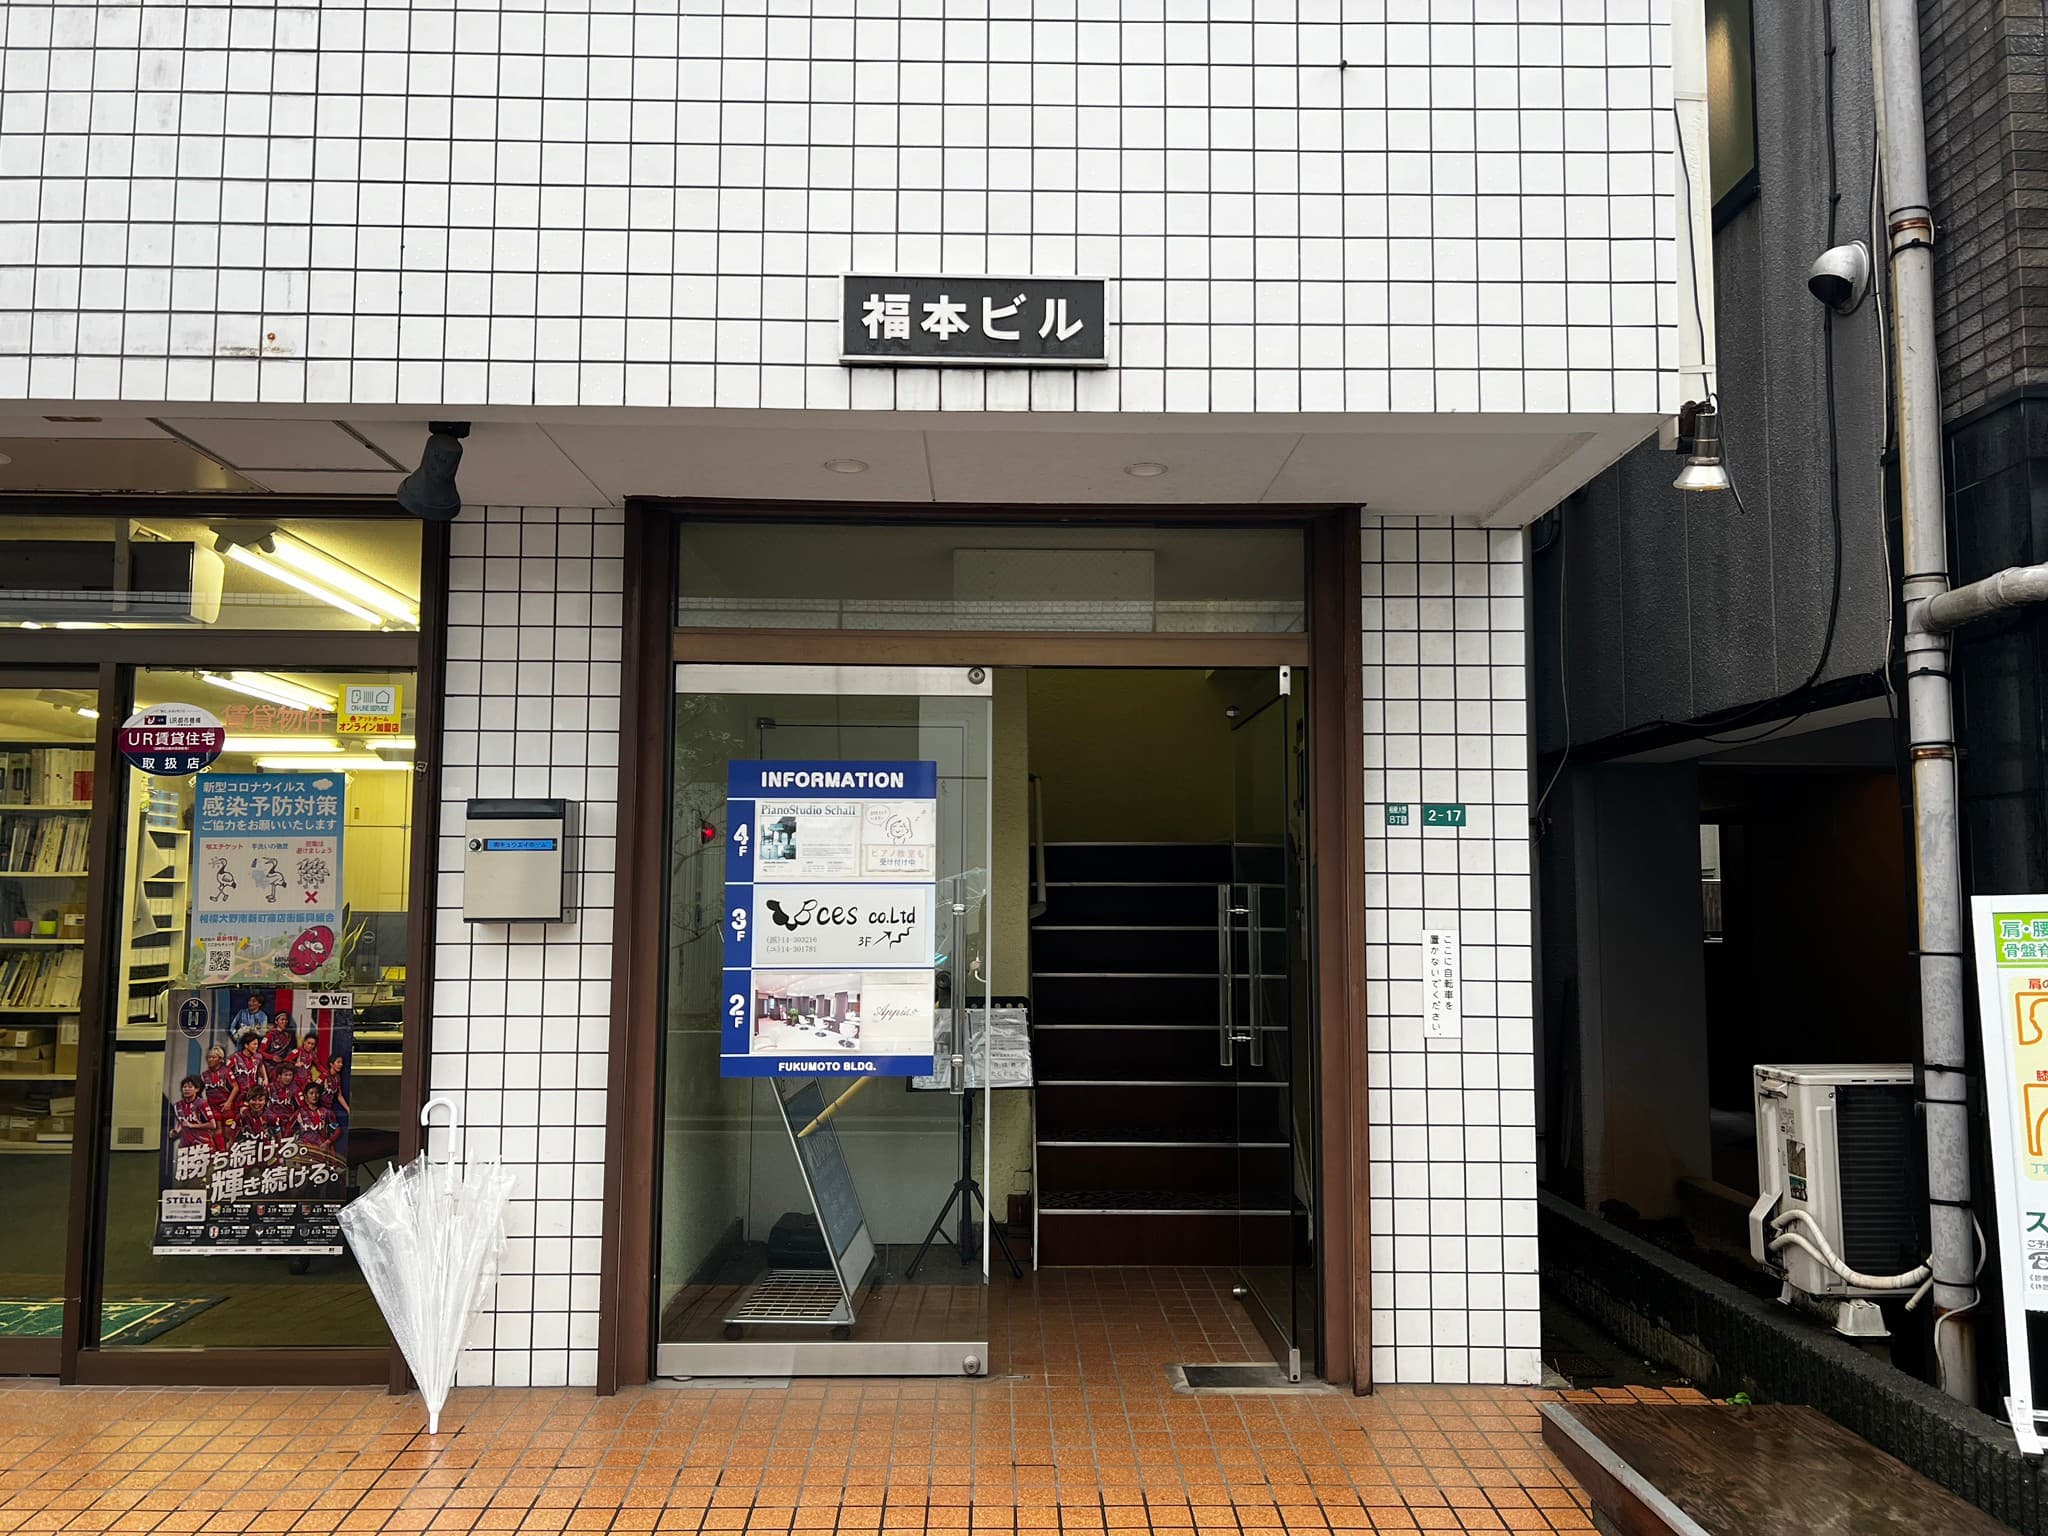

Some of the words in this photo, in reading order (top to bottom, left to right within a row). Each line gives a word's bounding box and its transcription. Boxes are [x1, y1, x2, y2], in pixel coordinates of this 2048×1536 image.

[861, 293, 1084, 342] 福本ビル
[222, 704, 331, 733] 賃貸物件
[128, 731, 216, 746] UR賃貸住宅
[142, 757, 200, 770] 取扱店
[203, 781, 305, 793] 新型コロナウイルス
[761, 771, 904, 789] INFORMATION
[202, 795, 337, 817] 感染予防対策
[761, 804, 822, 815] PianoStudio
[1389, 815, 1407, 824] 8丁目
[1428, 809, 1461, 822] 2-17
[201, 819, 337, 832] ご協力をお願いいたします
[868, 906, 916, 924] co.Ltd
[858, 937, 872, 947] 3F
[1444, 935, 1454, 1010] ここに自転車を
[778, 1062, 840, 1071] FUKUMOTO
[843, 1062, 876, 1071] BLDG.
[175, 1136, 308, 1182] 勝ち続ける。
[211, 1163, 339, 1204] 輝き続ける。
[2027, 1239, 2048, 1248] ご予
